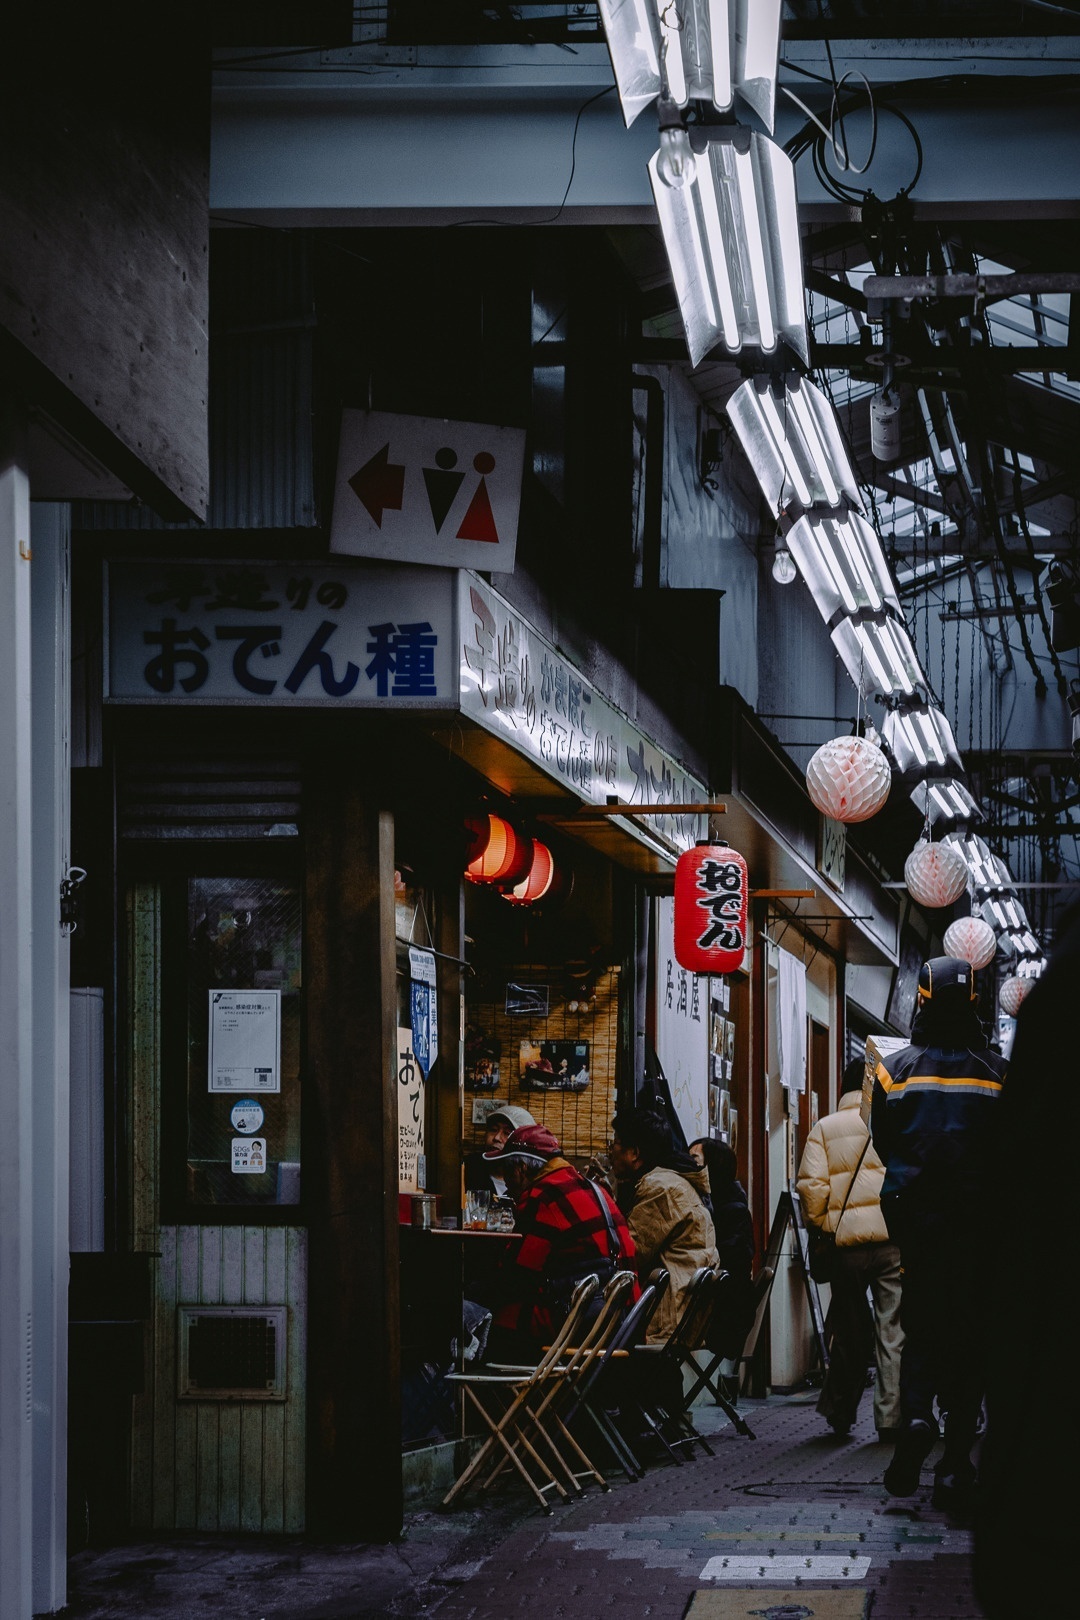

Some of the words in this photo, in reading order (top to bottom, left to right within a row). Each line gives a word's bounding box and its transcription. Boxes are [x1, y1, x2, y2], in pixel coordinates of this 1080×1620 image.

[143, 618, 438, 697] おでん種
[541, 653, 592, 738] かまぼこ
[539, 709, 592, 795] おでん種
[698, 860, 741, 950] おでん
[664, 959, 702, 1023] 居酒屋
